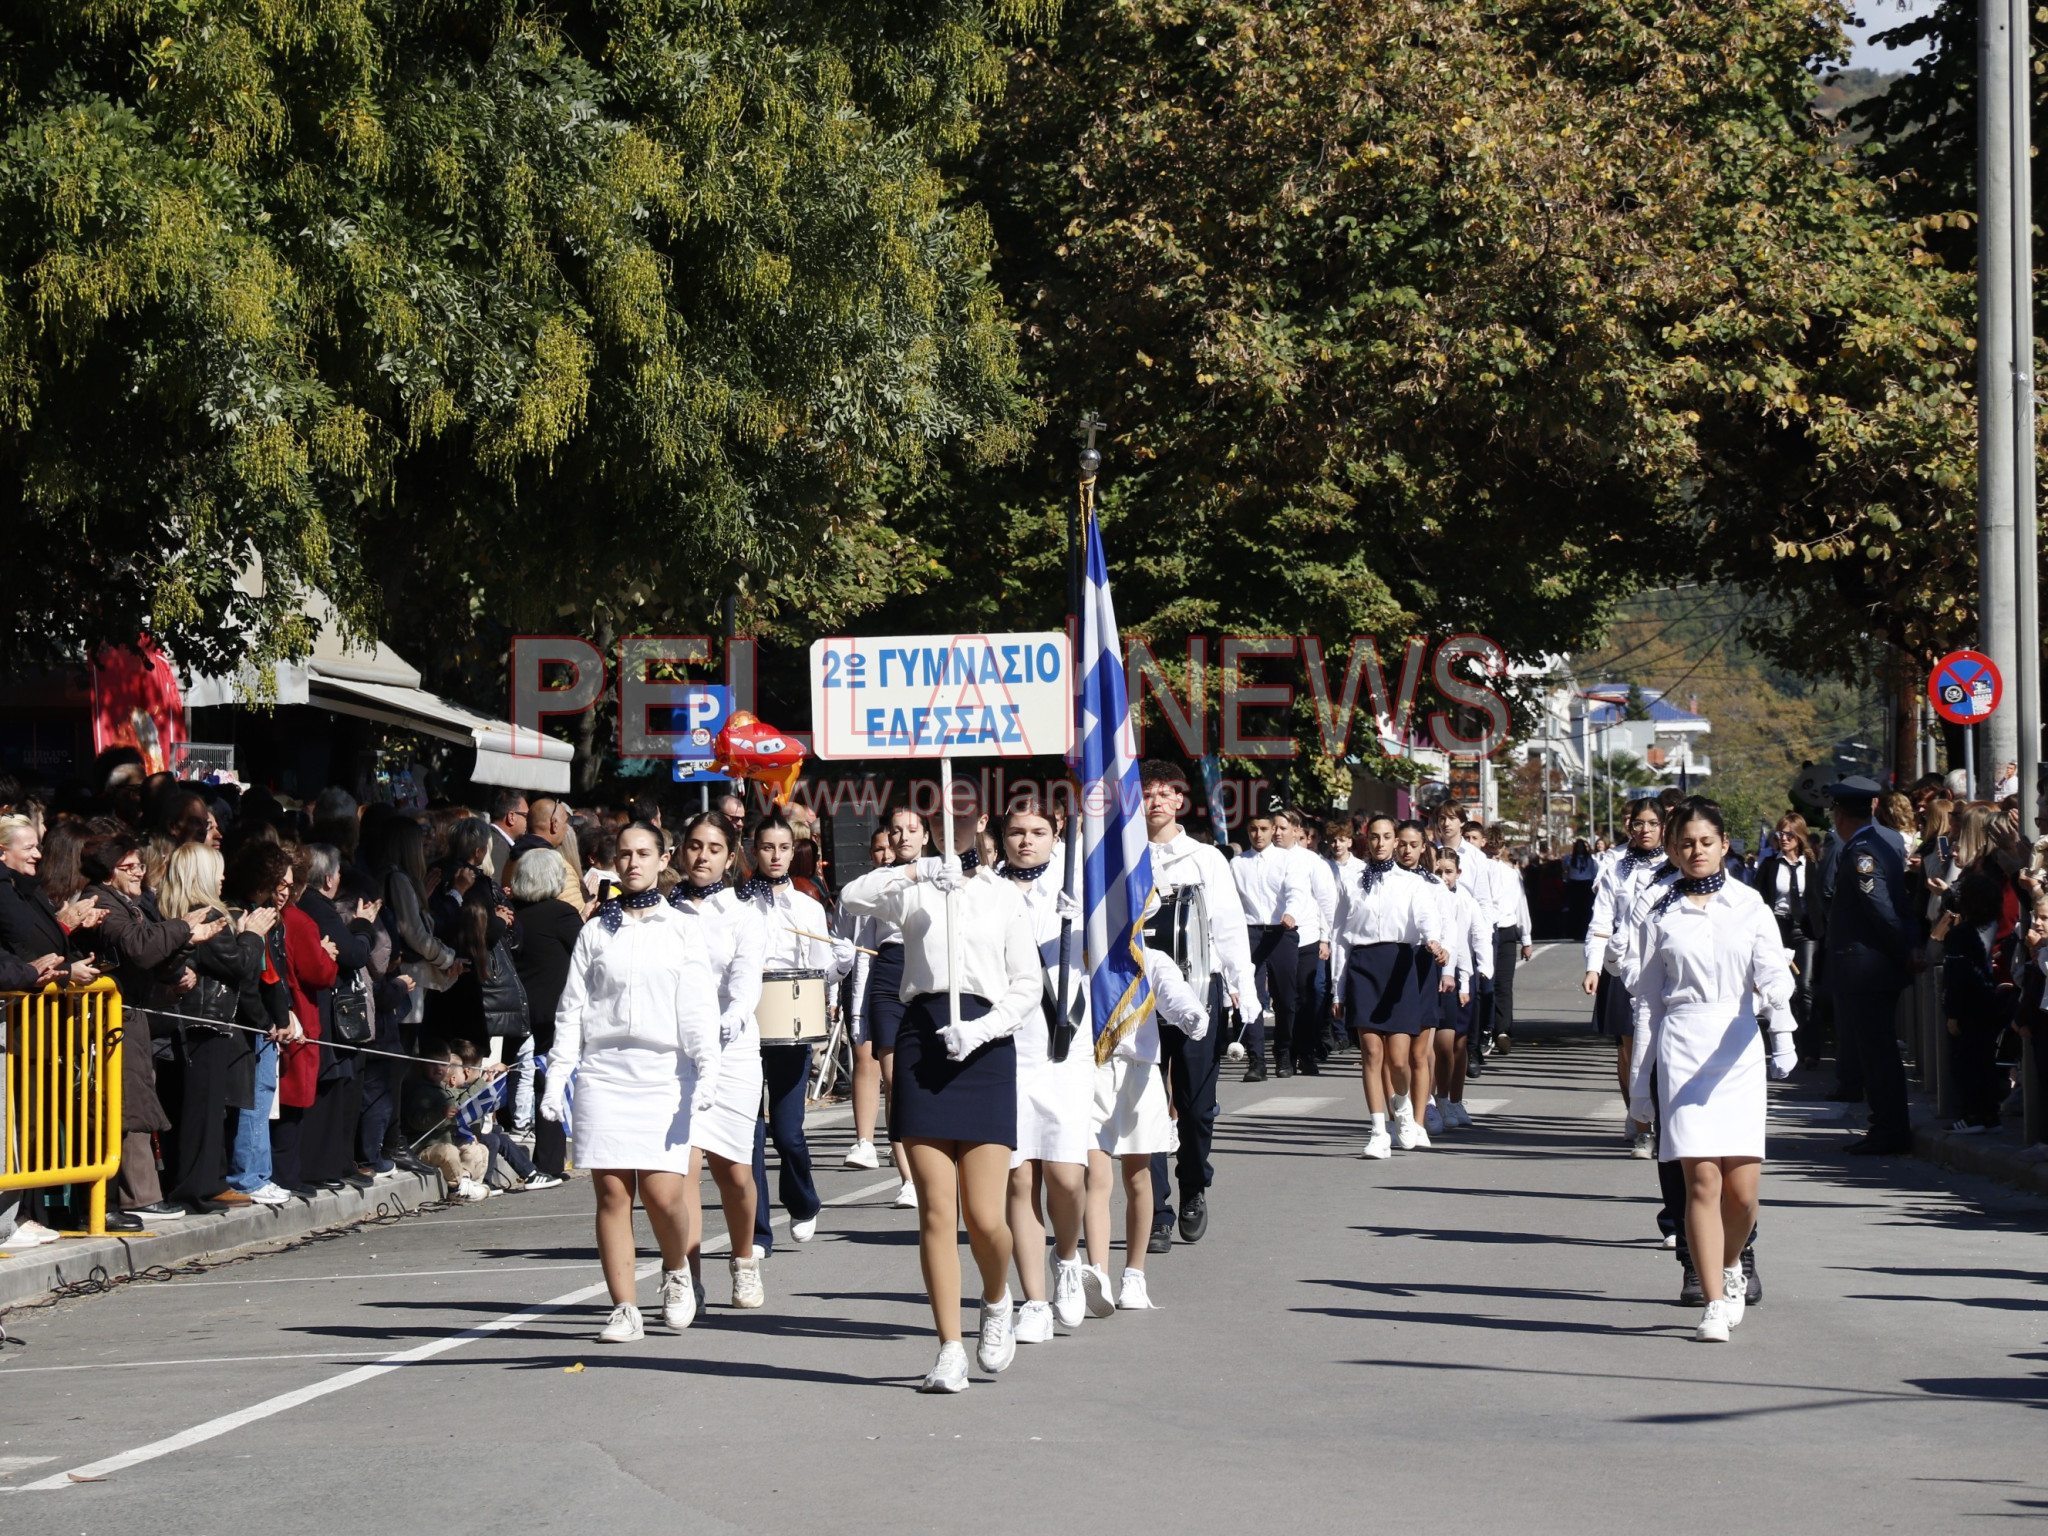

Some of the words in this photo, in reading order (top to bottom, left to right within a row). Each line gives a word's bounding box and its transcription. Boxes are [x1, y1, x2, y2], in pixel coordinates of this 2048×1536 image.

[879, 643, 1061, 687] ΓΥΜΝΑΣΙΟ
[689, 694, 720, 730] P
[866, 704, 1022, 746] ΕΔΕΣΣΑΣ
